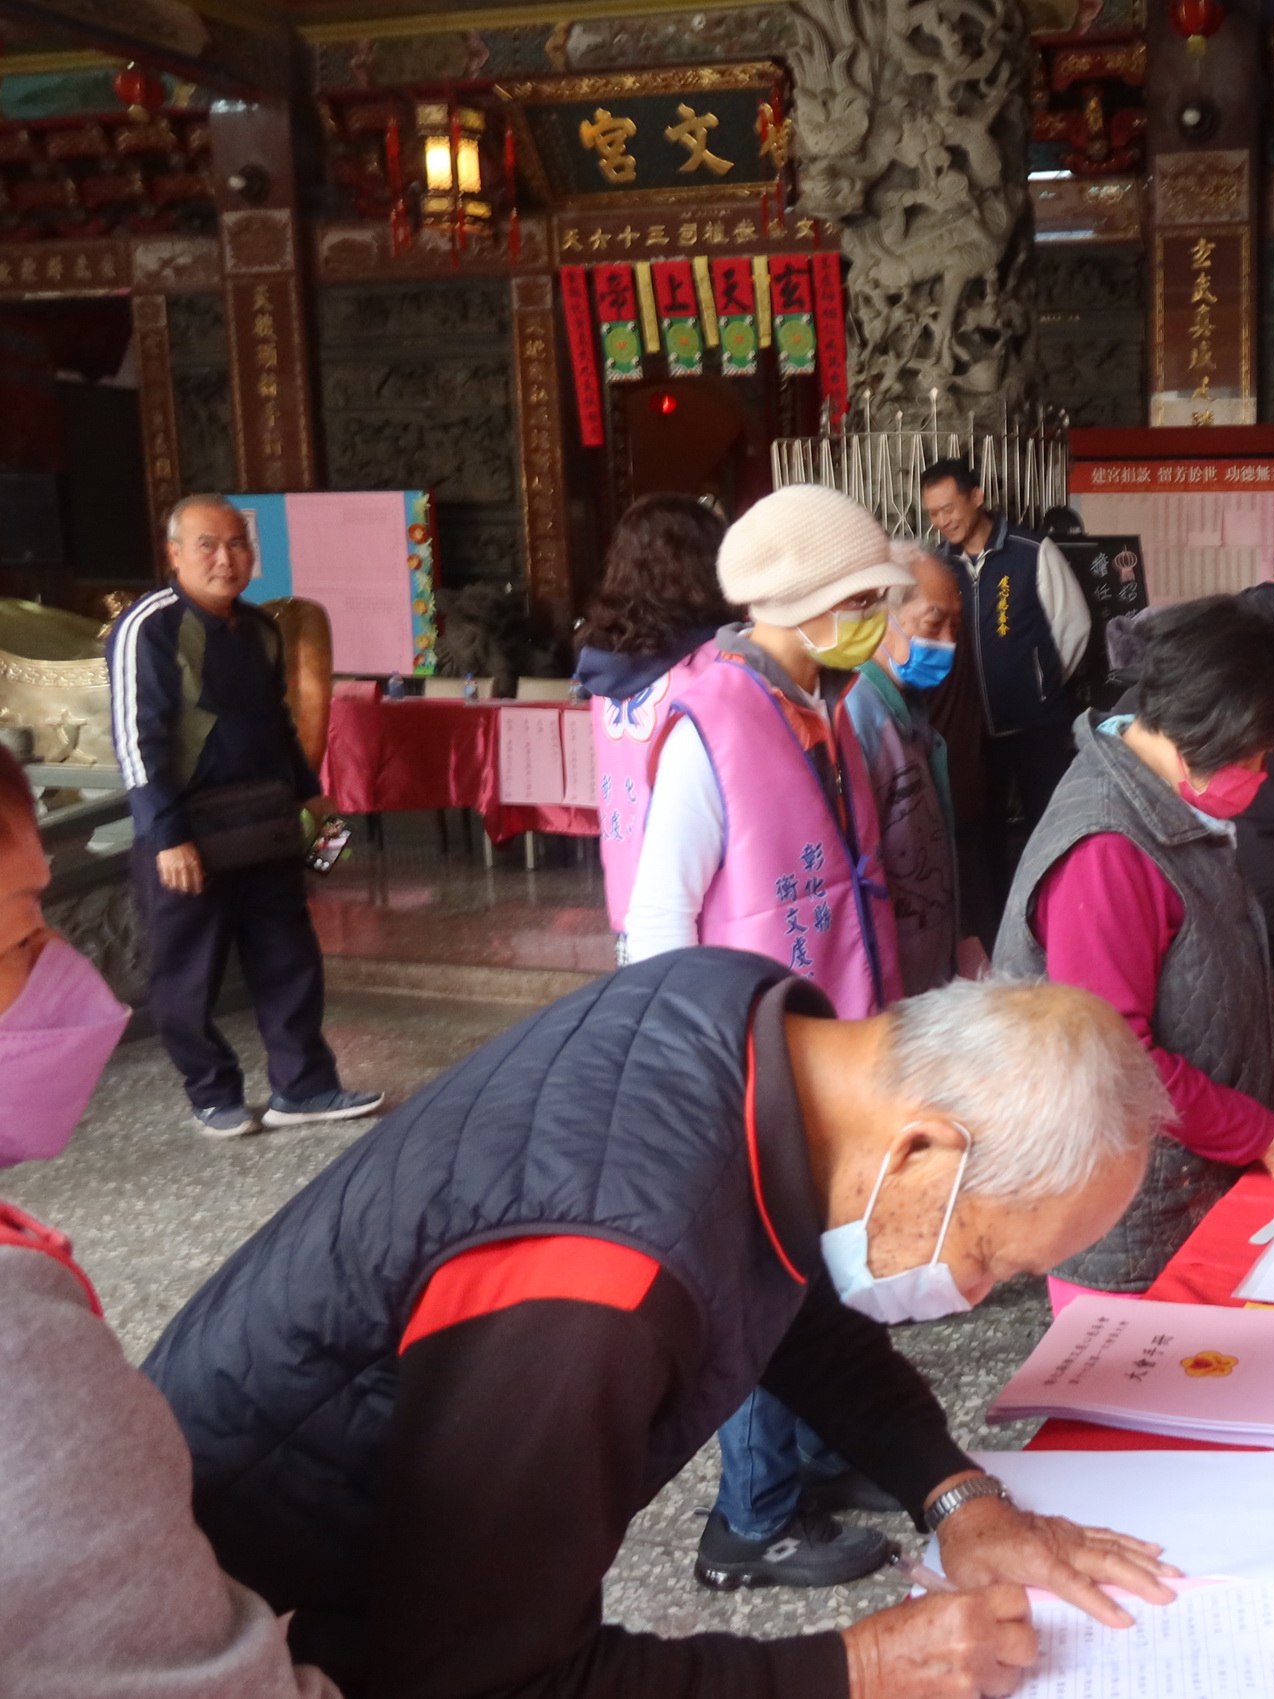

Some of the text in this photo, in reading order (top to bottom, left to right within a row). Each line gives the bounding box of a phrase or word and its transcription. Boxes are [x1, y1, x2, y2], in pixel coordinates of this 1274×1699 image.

[601, 264, 809, 320] 玄天上帝
[1091, 466, 1151, 484] 建宮捐款
[1157, 465, 1218, 483] 留芳於世
[801, 842, 832, 933] 彰化縣
[775, 873, 816, 978] 衡文虔
